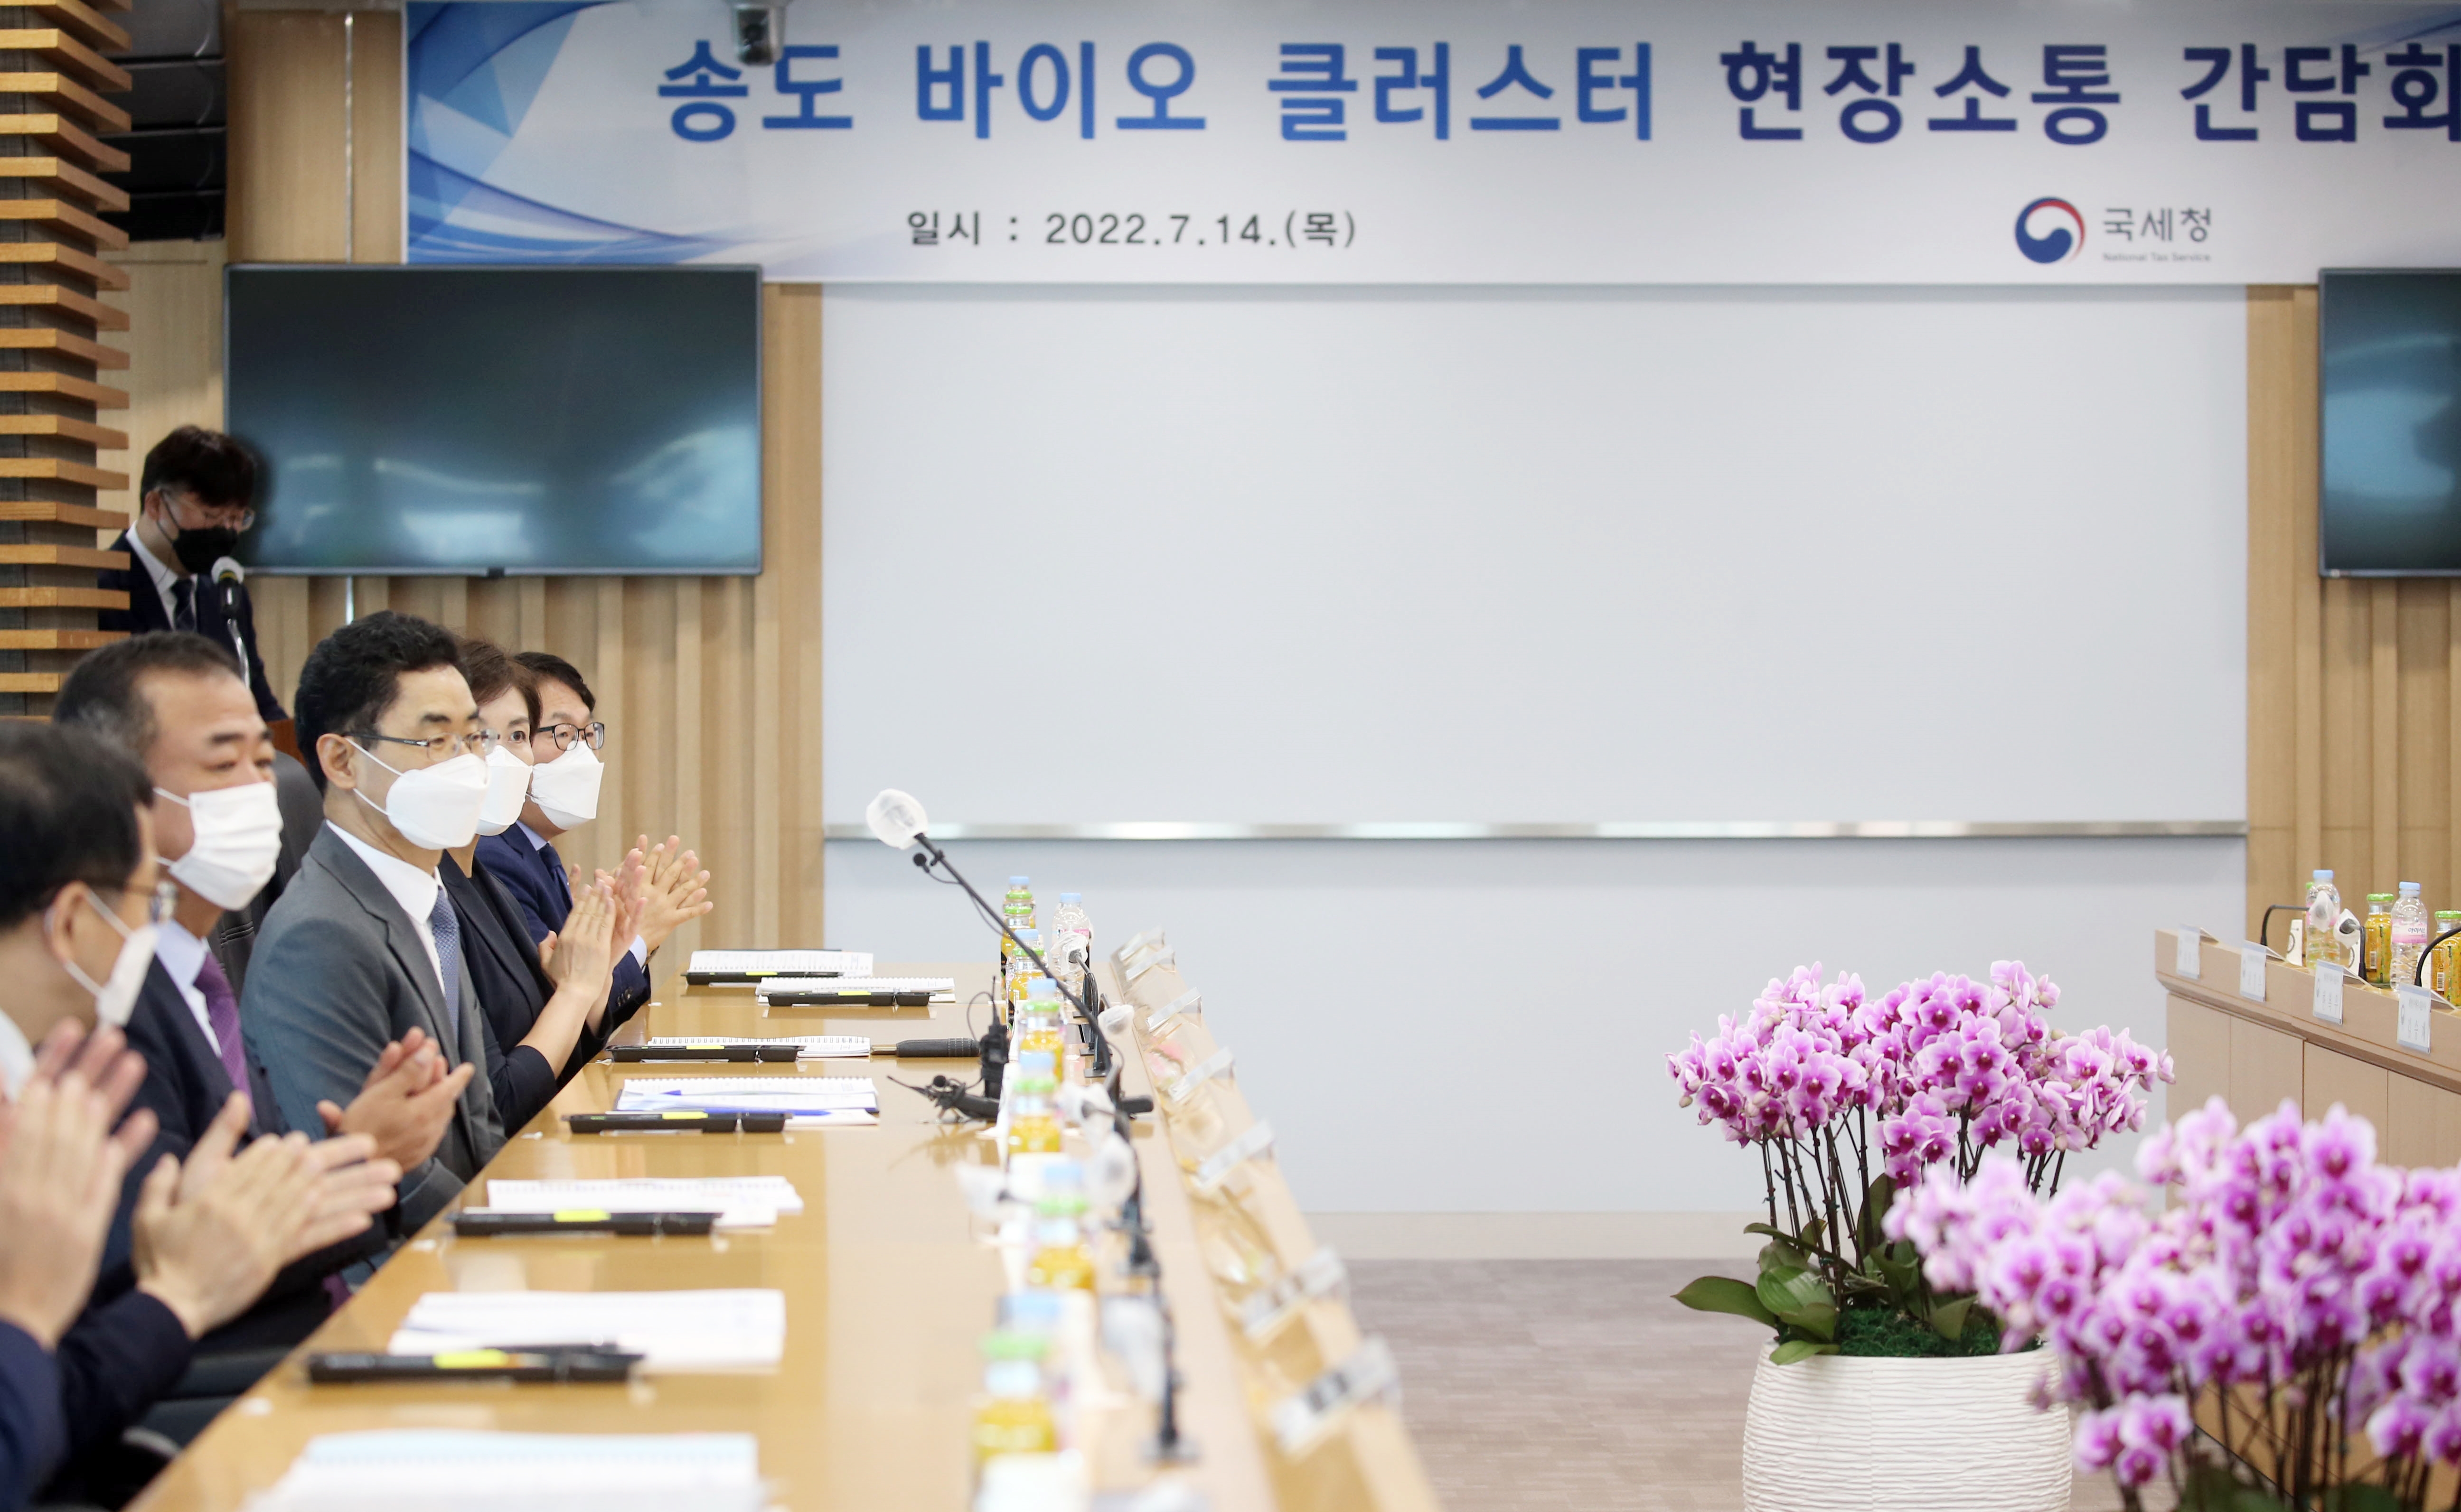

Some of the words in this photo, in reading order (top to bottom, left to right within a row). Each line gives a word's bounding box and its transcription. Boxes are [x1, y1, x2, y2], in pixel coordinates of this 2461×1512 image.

[658, 39, 854, 142] 송도
[915, 39, 1206, 140] 바이오
[1267, 41, 1653, 142] 클러스터
[1719, 41, 2121, 144] 현장소통
[2180, 43, 2461, 142] 간담회
[908, 211, 979, 246] 일시
[1010, 217, 1017, 242] :
[1046, 211, 1355, 248] 2022.7.14.(목)
[2103, 207, 2211, 243] 국세청
[2103, 252, 2148, 261] National
[2151, 252, 2169, 261] Tax
[2172, 252, 2211, 262] Service
